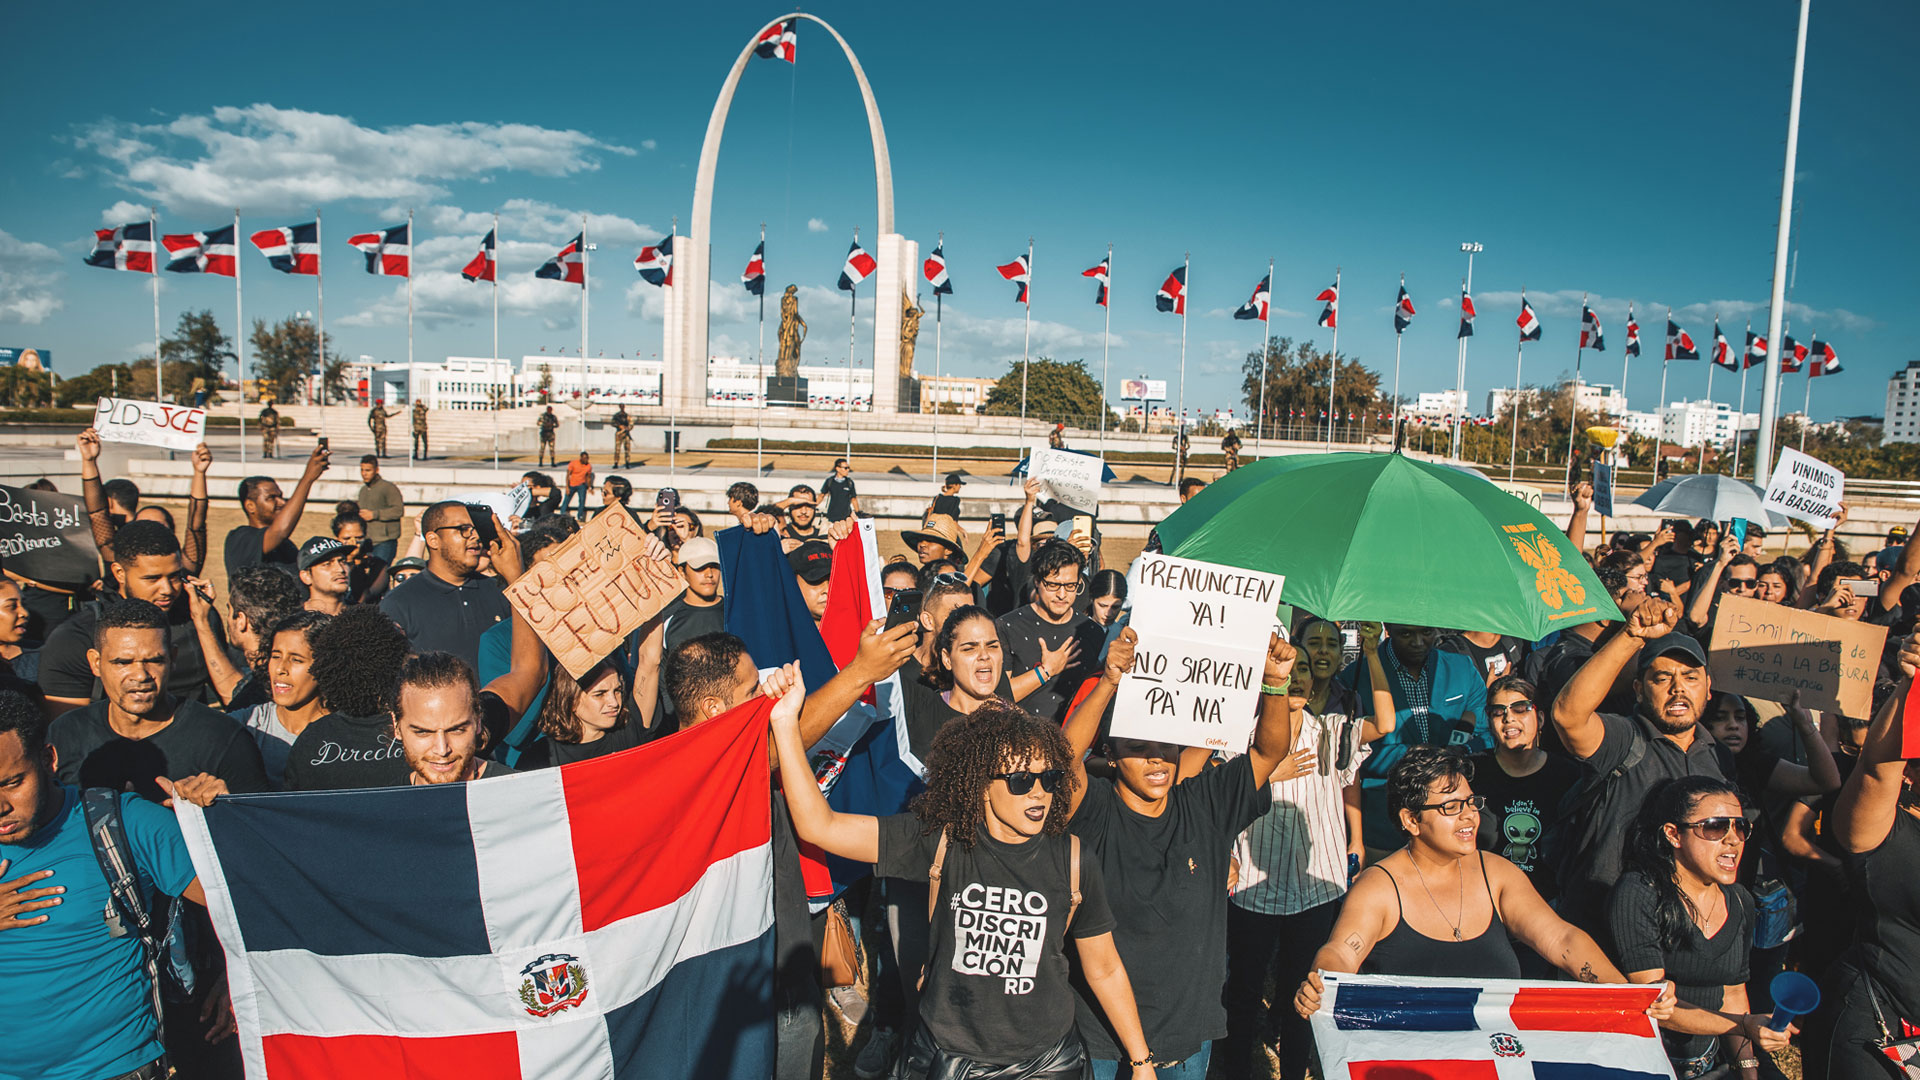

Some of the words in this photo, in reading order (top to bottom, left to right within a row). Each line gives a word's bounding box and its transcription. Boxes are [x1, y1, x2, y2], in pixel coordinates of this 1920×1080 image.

[1792, 460, 1836, 488] VINIMOS
[1770, 488, 1786, 504] LA
[1791, 480, 1799, 490] A
[1800, 483, 1829, 501] SACAR
[0, 488, 49, 527] Basta
[53, 504, 80, 529] ya!
[1140, 557, 1275, 603] ¡RENUNCIEN
[547, 554, 679, 653] FUTURO
[1727, 614, 1752, 633] 15
[1756, 624, 1783, 641] mil
[1791, 628, 1843, 654] millones
[1851, 644, 1866, 659] de
[1133, 651, 1168, 676] NO
[1176, 657, 1253, 690] SIRVEN
[1728, 639, 1765, 664] Pesos
[1773, 653, 1783, 667] A
[1793, 657, 1811, 672] LA
[1818, 659, 1869, 683] BASURA
[310, 734, 405, 766] Directo
[1504, 806, 1531, 814] believe
[1533, 807, 1541, 816] in
[950, 883, 1048, 915] #CERO
[958, 909, 1041, 940] DISCRI
[965, 931, 1026, 958] MINA
[963, 950, 1023, 977] CIÓN
[1004, 978, 1035, 995] RD
